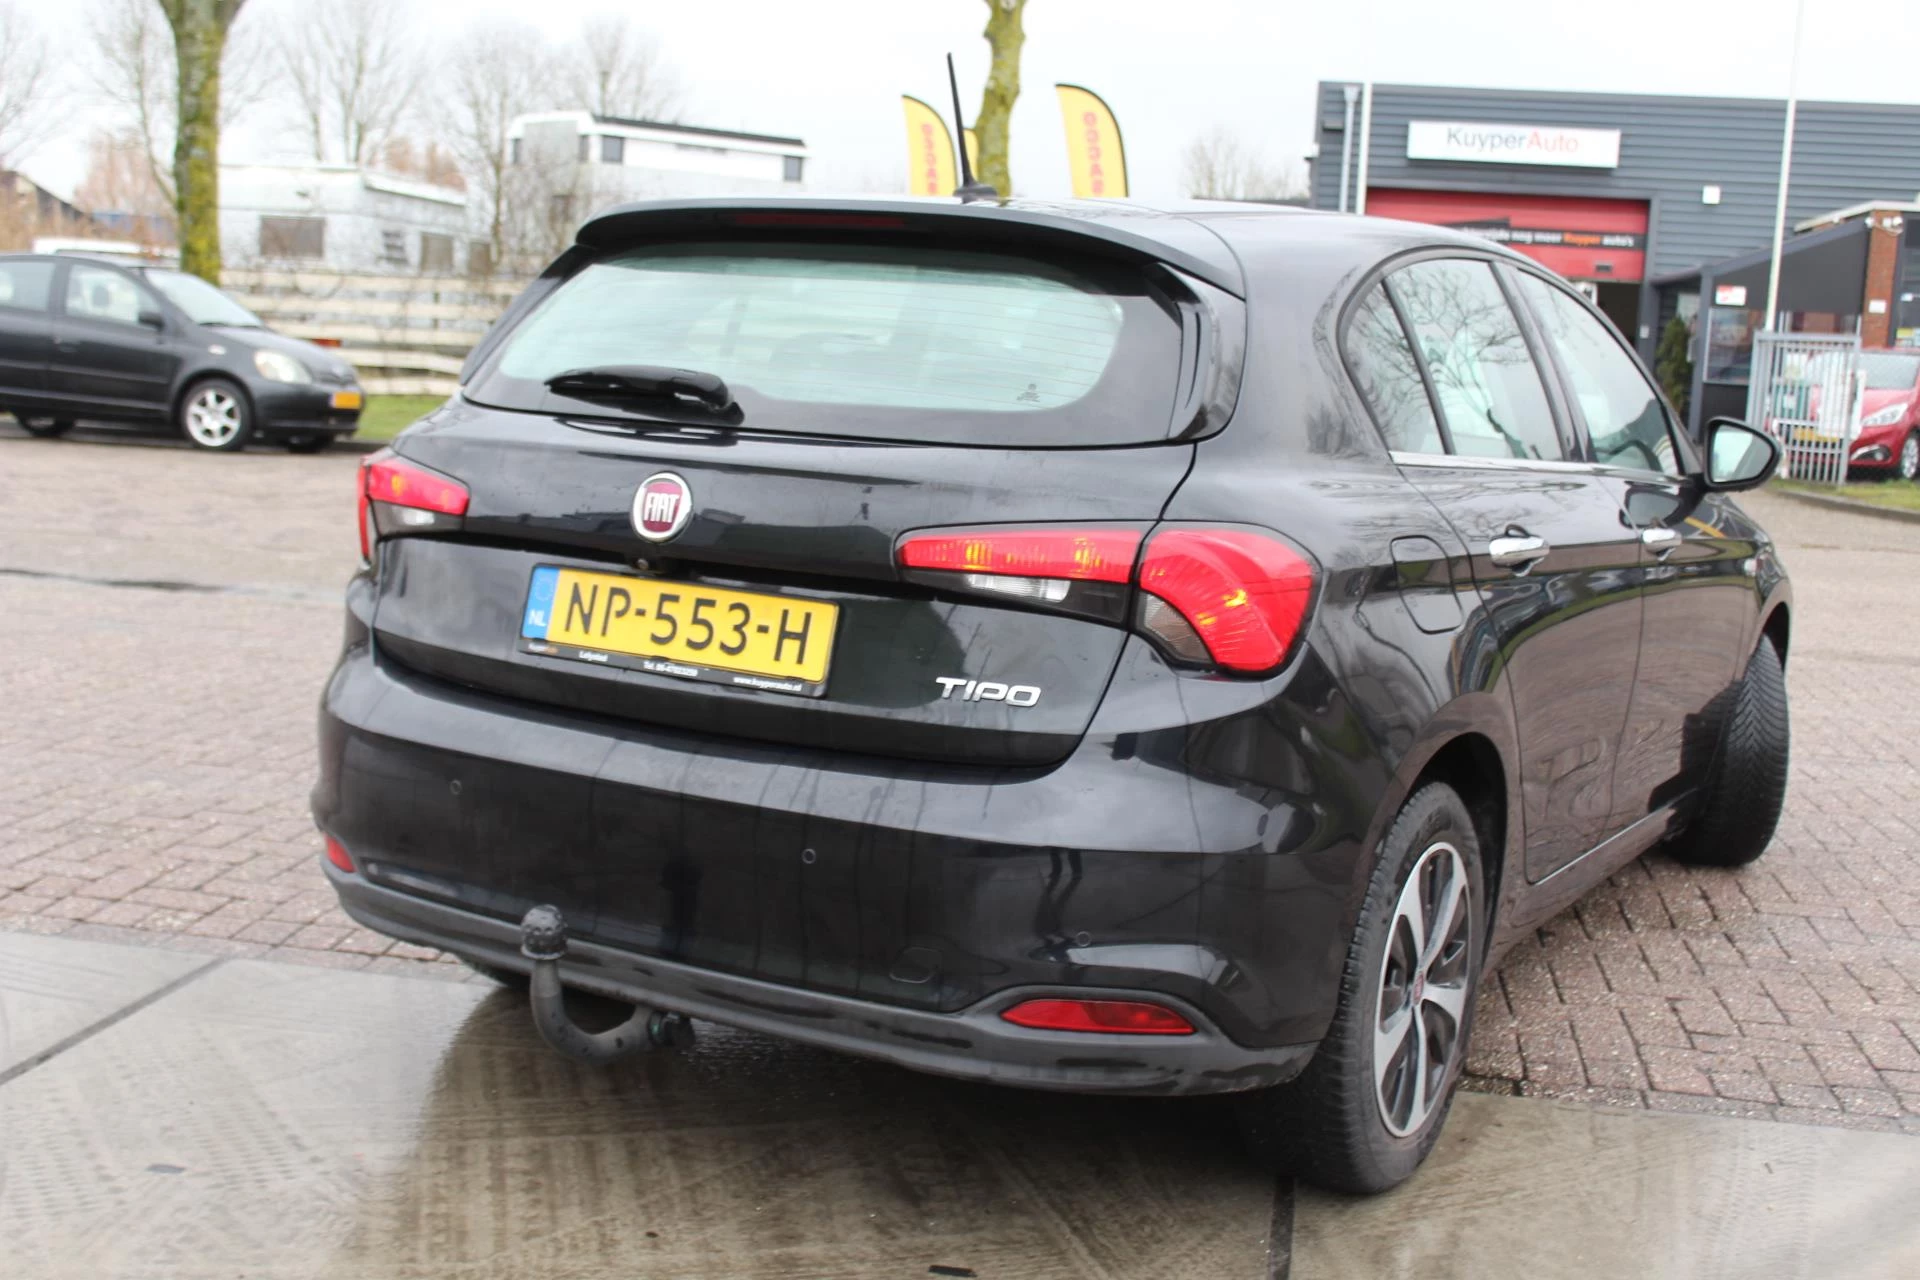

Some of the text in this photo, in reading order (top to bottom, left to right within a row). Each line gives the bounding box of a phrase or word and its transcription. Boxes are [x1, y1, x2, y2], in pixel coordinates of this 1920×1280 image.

[1446, 127, 1579, 153] KuyperAuto
[643, 492, 681, 523] FIAT
[528, 608, 548, 627] NL
[564, 582, 812, 665] NP-553-H
[936, 676, 1042, 707] TIPO
